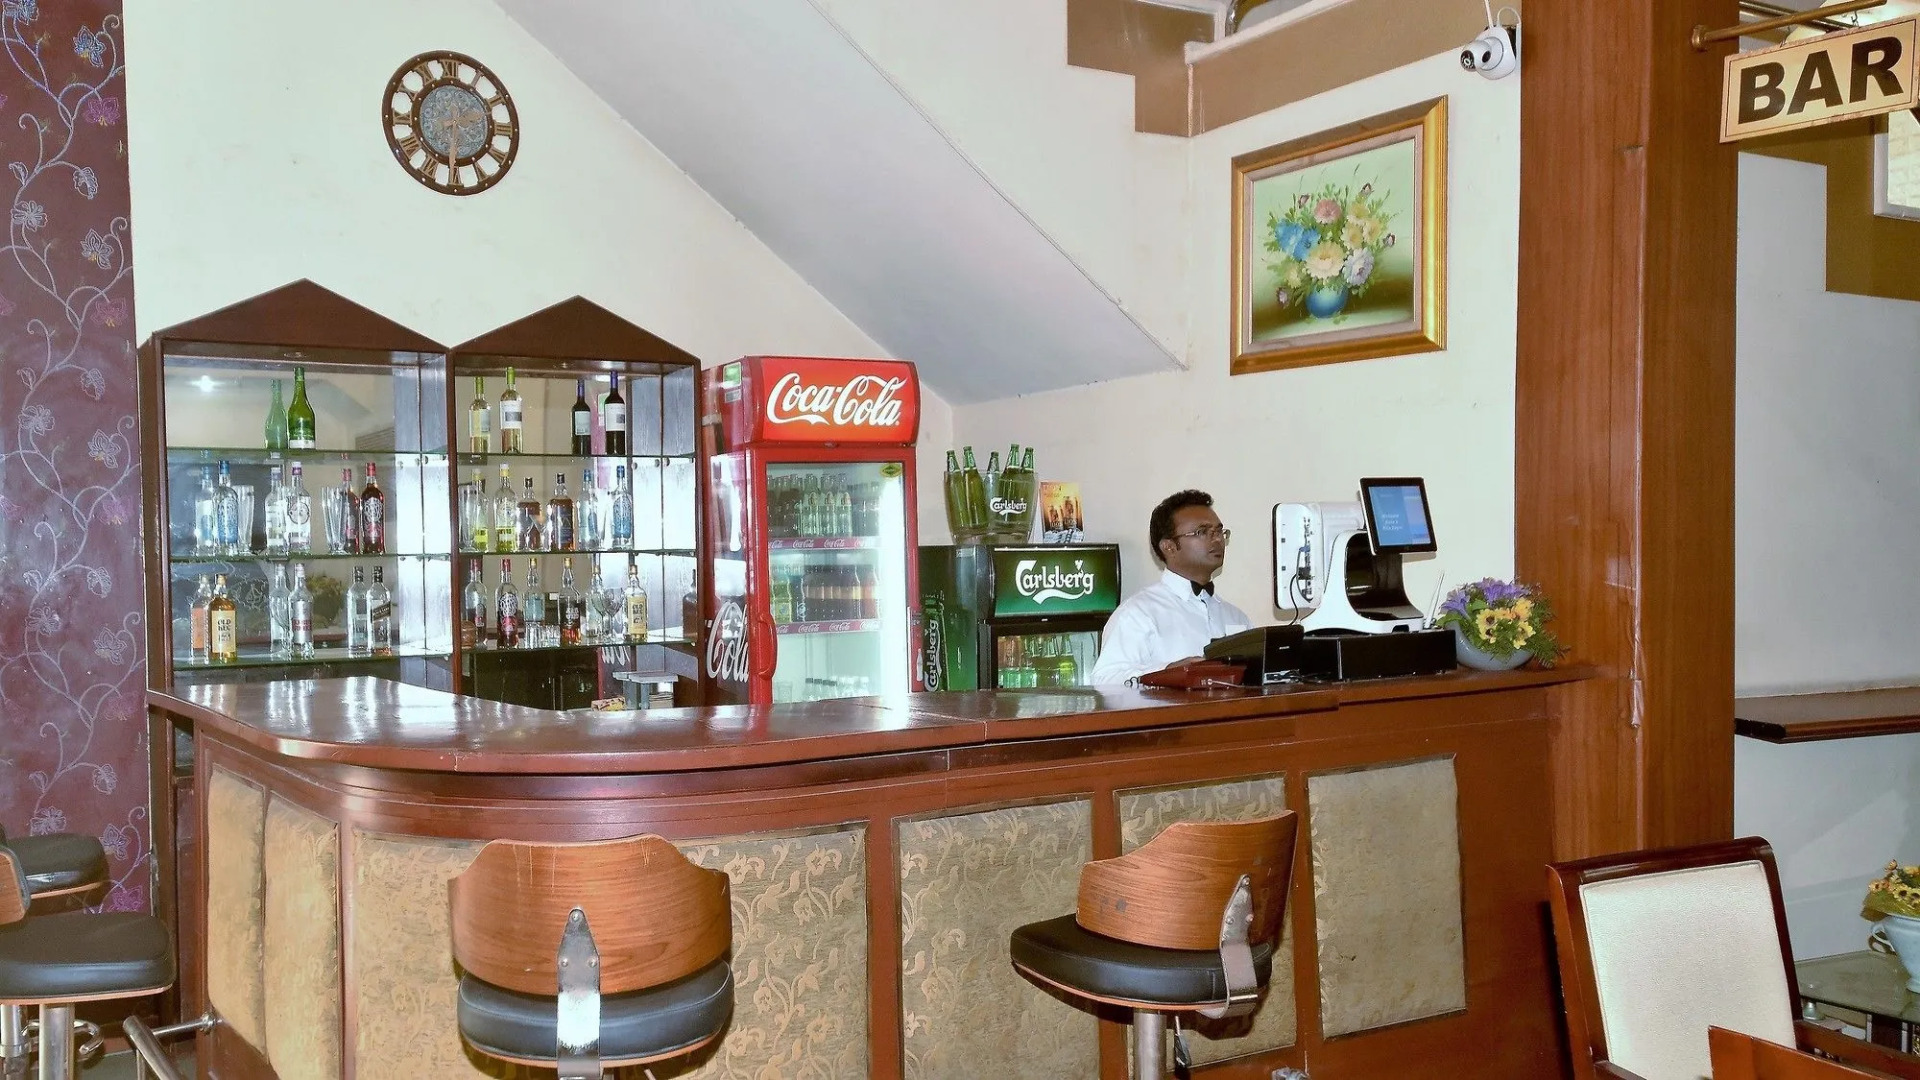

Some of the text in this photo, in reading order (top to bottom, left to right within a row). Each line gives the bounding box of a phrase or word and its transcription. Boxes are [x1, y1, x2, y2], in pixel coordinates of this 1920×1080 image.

[1738, 36, 1904, 125] BAR
[767, 372, 909, 427] Coca-Cola
[989, 497, 1028, 516] Carlsberg
[1015, 559, 1095, 605] Carlsberg
[924, 619, 942, 692] Carlsberg
